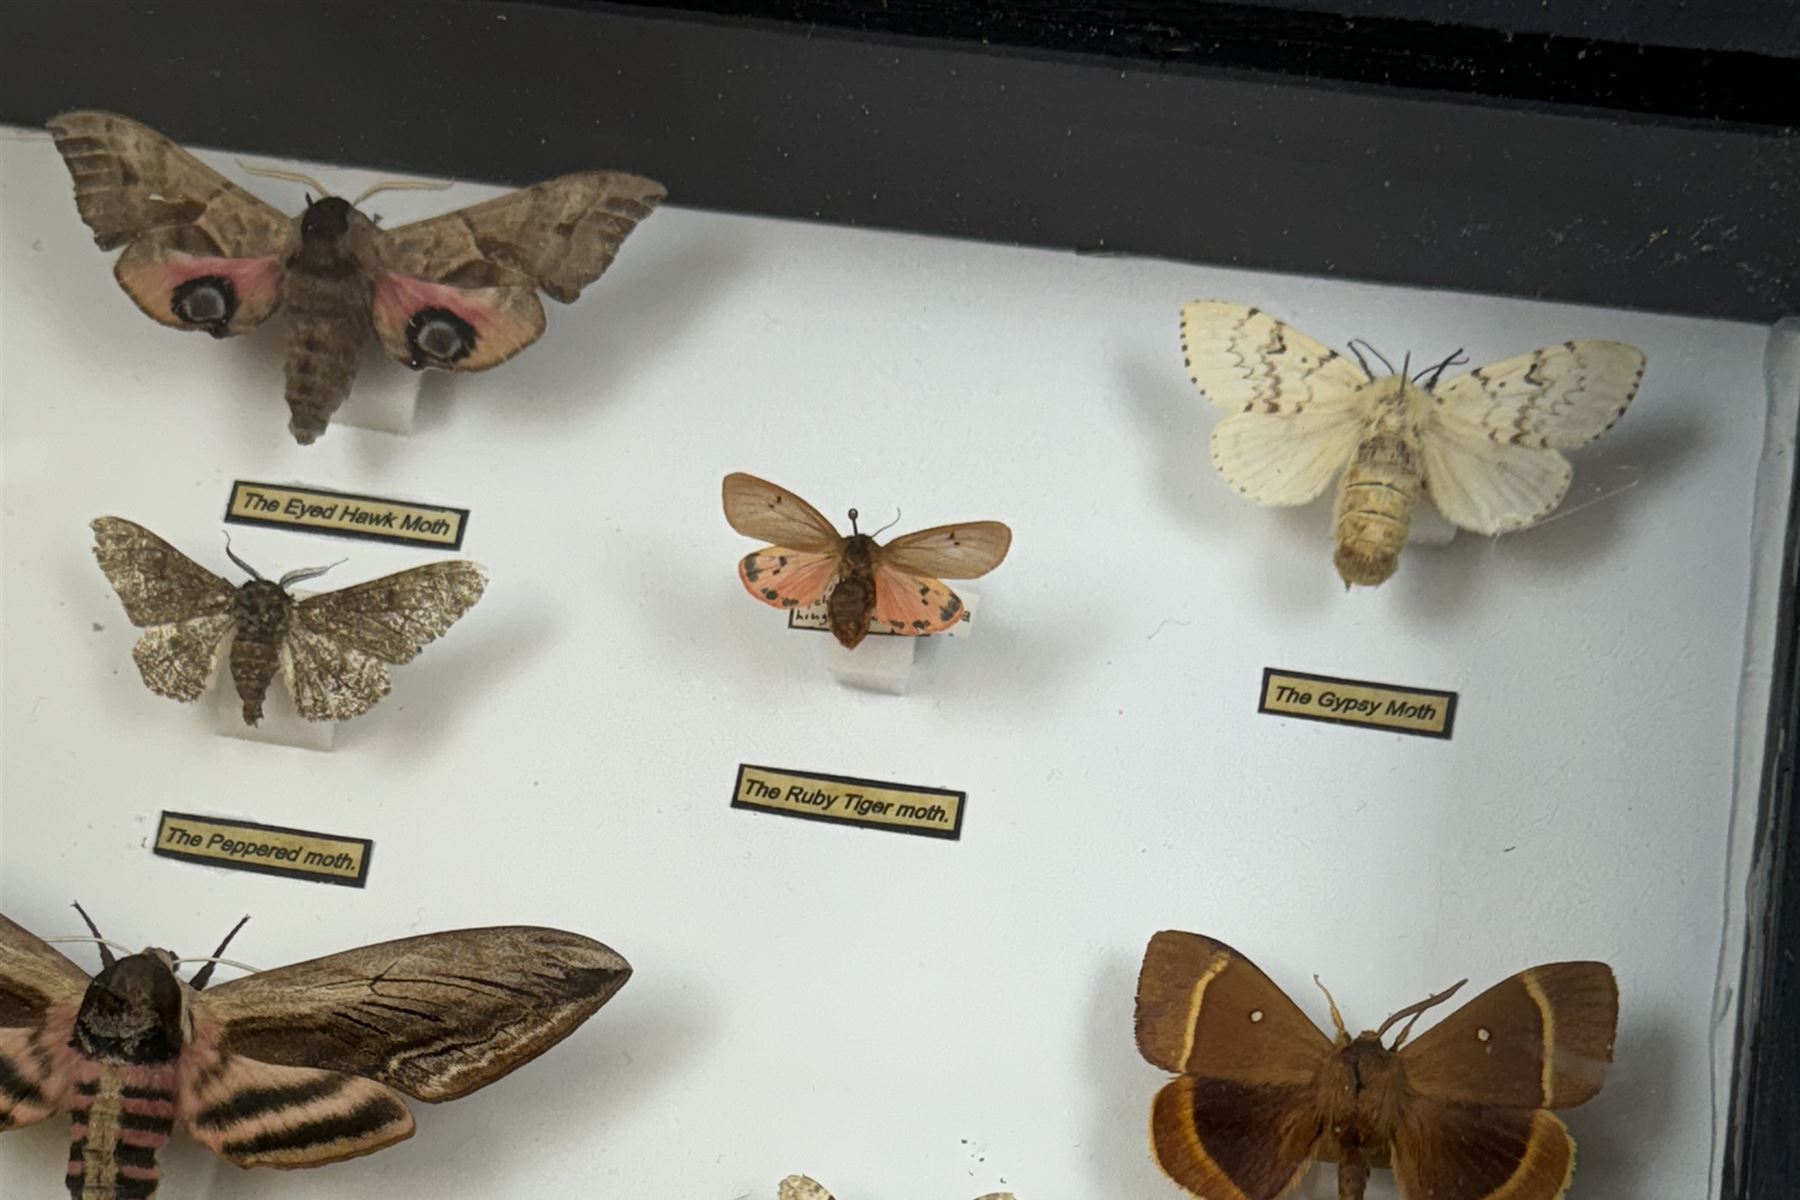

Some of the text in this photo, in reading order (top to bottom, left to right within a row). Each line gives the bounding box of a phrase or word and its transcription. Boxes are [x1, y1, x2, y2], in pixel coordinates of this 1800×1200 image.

[244, 492, 450, 536] The Eyed Hawk Moth
[1276, 686, 1436, 720] The Gypsy Moth
[745, 779, 949, 823] The Ruby Tiger moth.
[166, 827, 356, 870] The Peppered moth.
